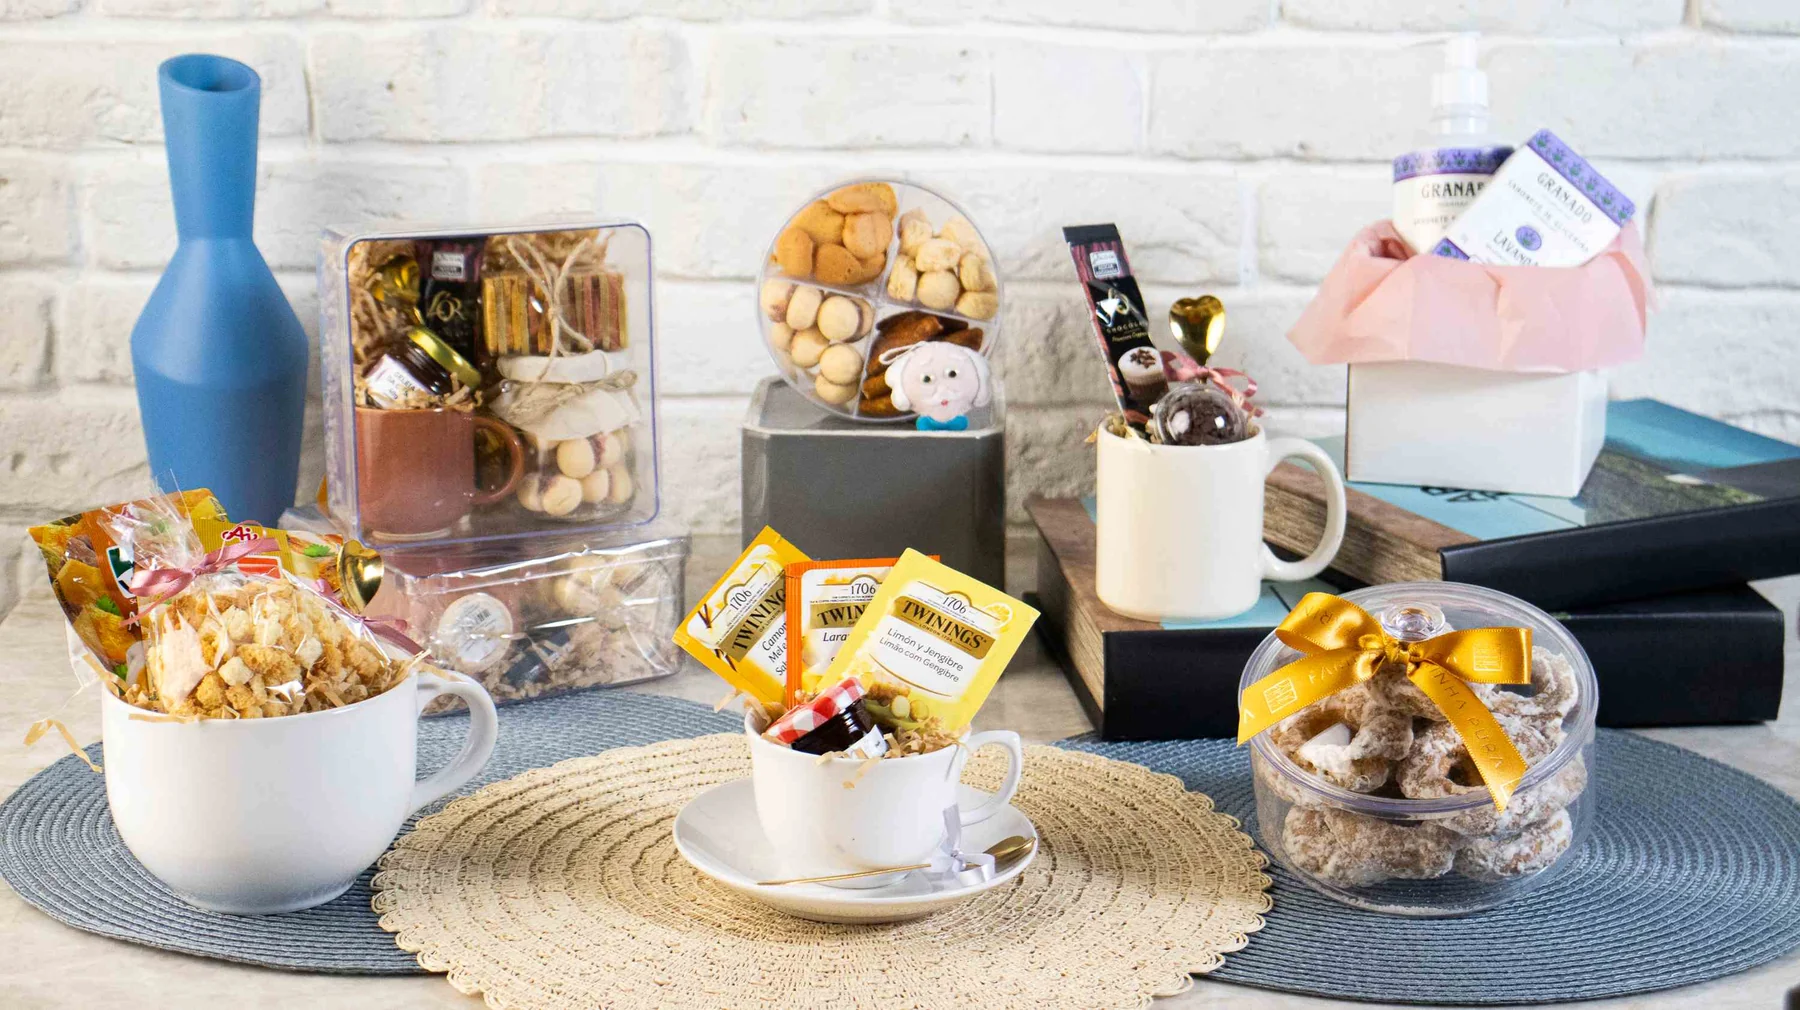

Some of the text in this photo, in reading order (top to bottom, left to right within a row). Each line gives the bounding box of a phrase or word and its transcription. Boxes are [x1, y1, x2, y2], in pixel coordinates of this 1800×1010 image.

[1537, 172, 1593, 223] GRANADO
[730, 589, 752, 611] 1706
[851, 583, 876, 595] 1706
[942, 596, 967, 614] 1706
[823, 632, 850, 642] Lara
[902, 600, 984, 649] TWININGS
[879, 637, 960, 683] Limão com Gengibre
[887, 628, 964, 672] Limón y Jengibre
